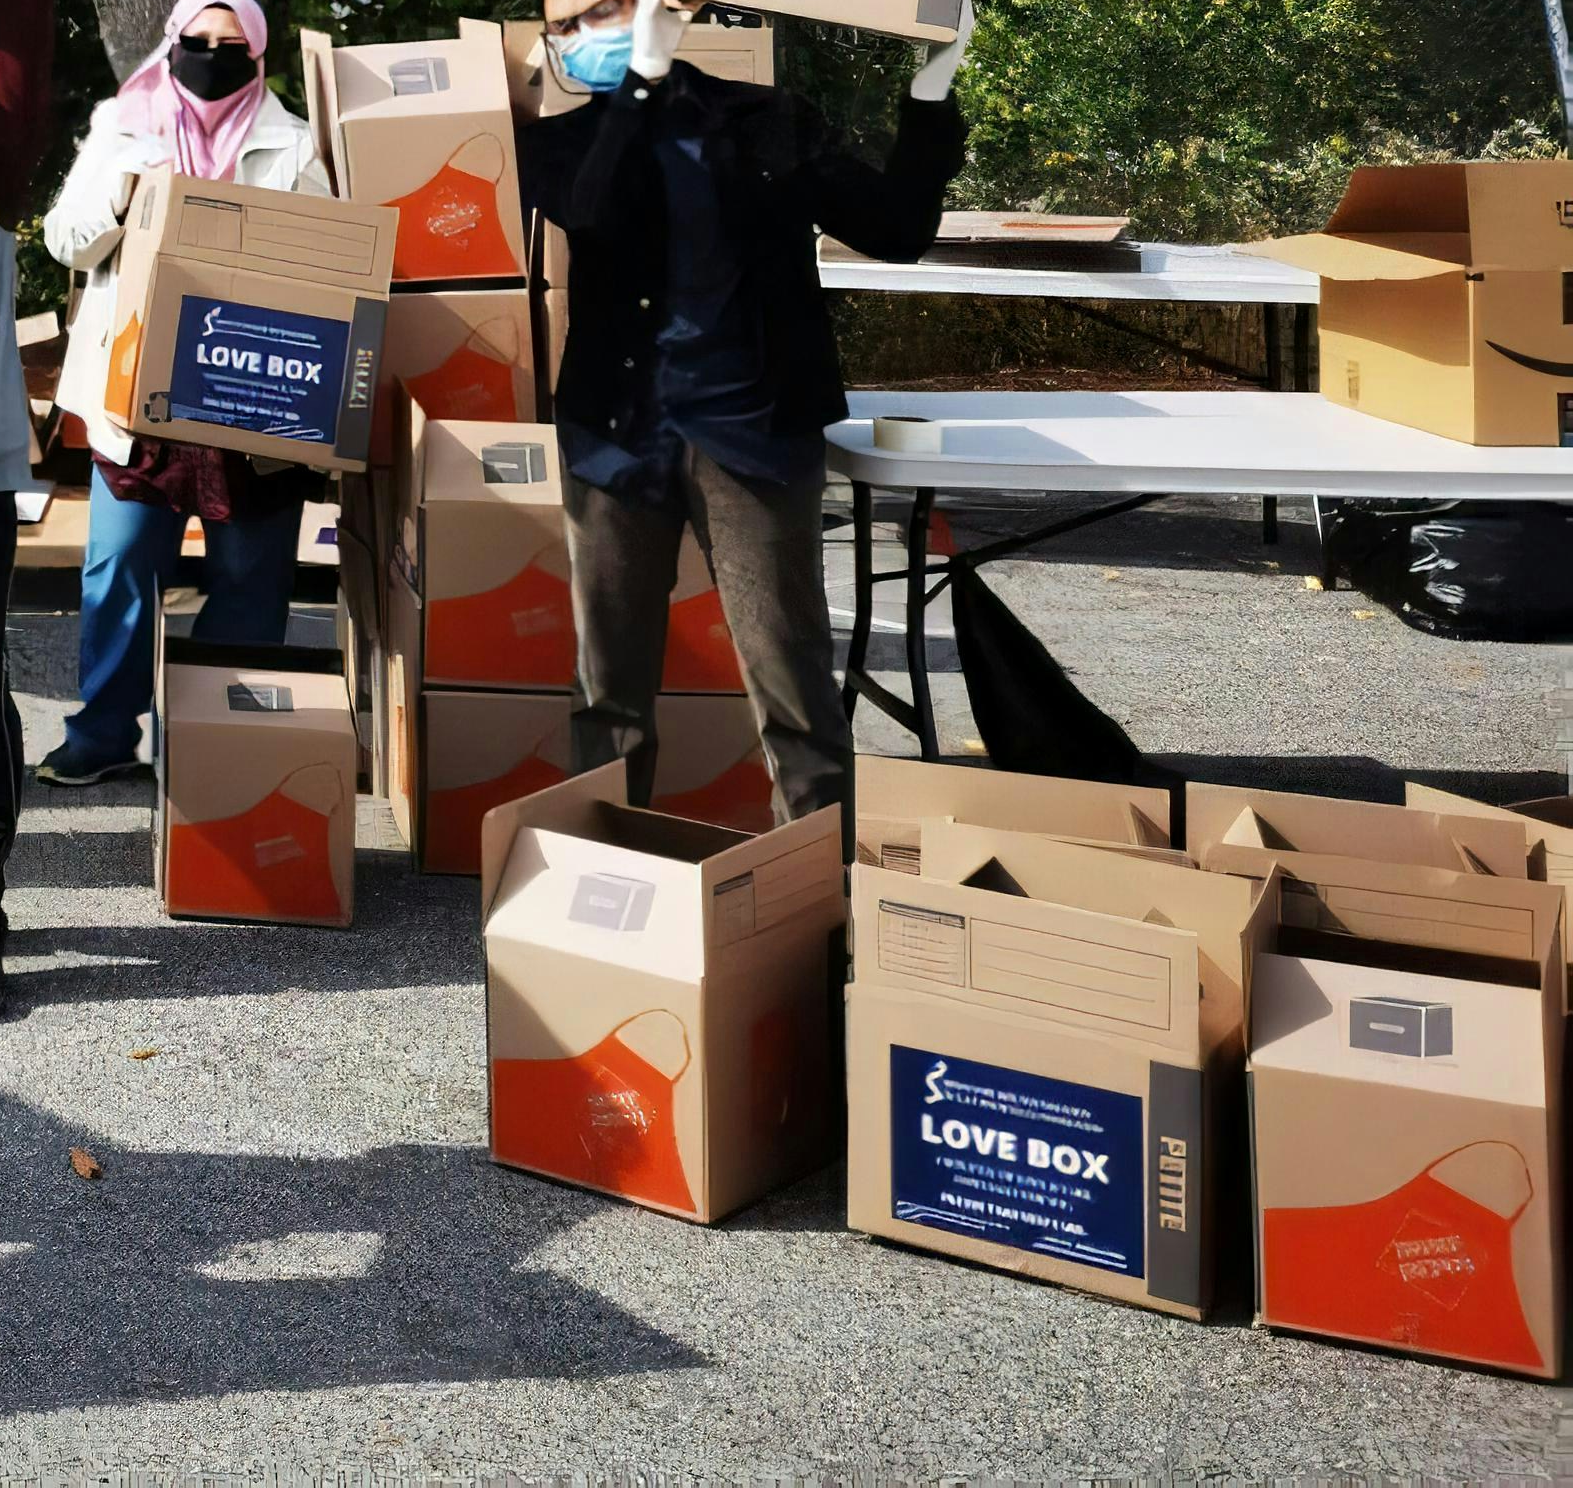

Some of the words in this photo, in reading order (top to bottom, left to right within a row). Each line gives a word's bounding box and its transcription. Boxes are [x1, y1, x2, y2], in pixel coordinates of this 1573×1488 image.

[196, 342, 261, 374] LOVE
[267, 355, 323, 385] BOX
[920, 1113, 1018, 1162] LOVE
[1027, 1137, 1110, 1185] BOX
[1159, 1134, 1187, 1233] PETITE
